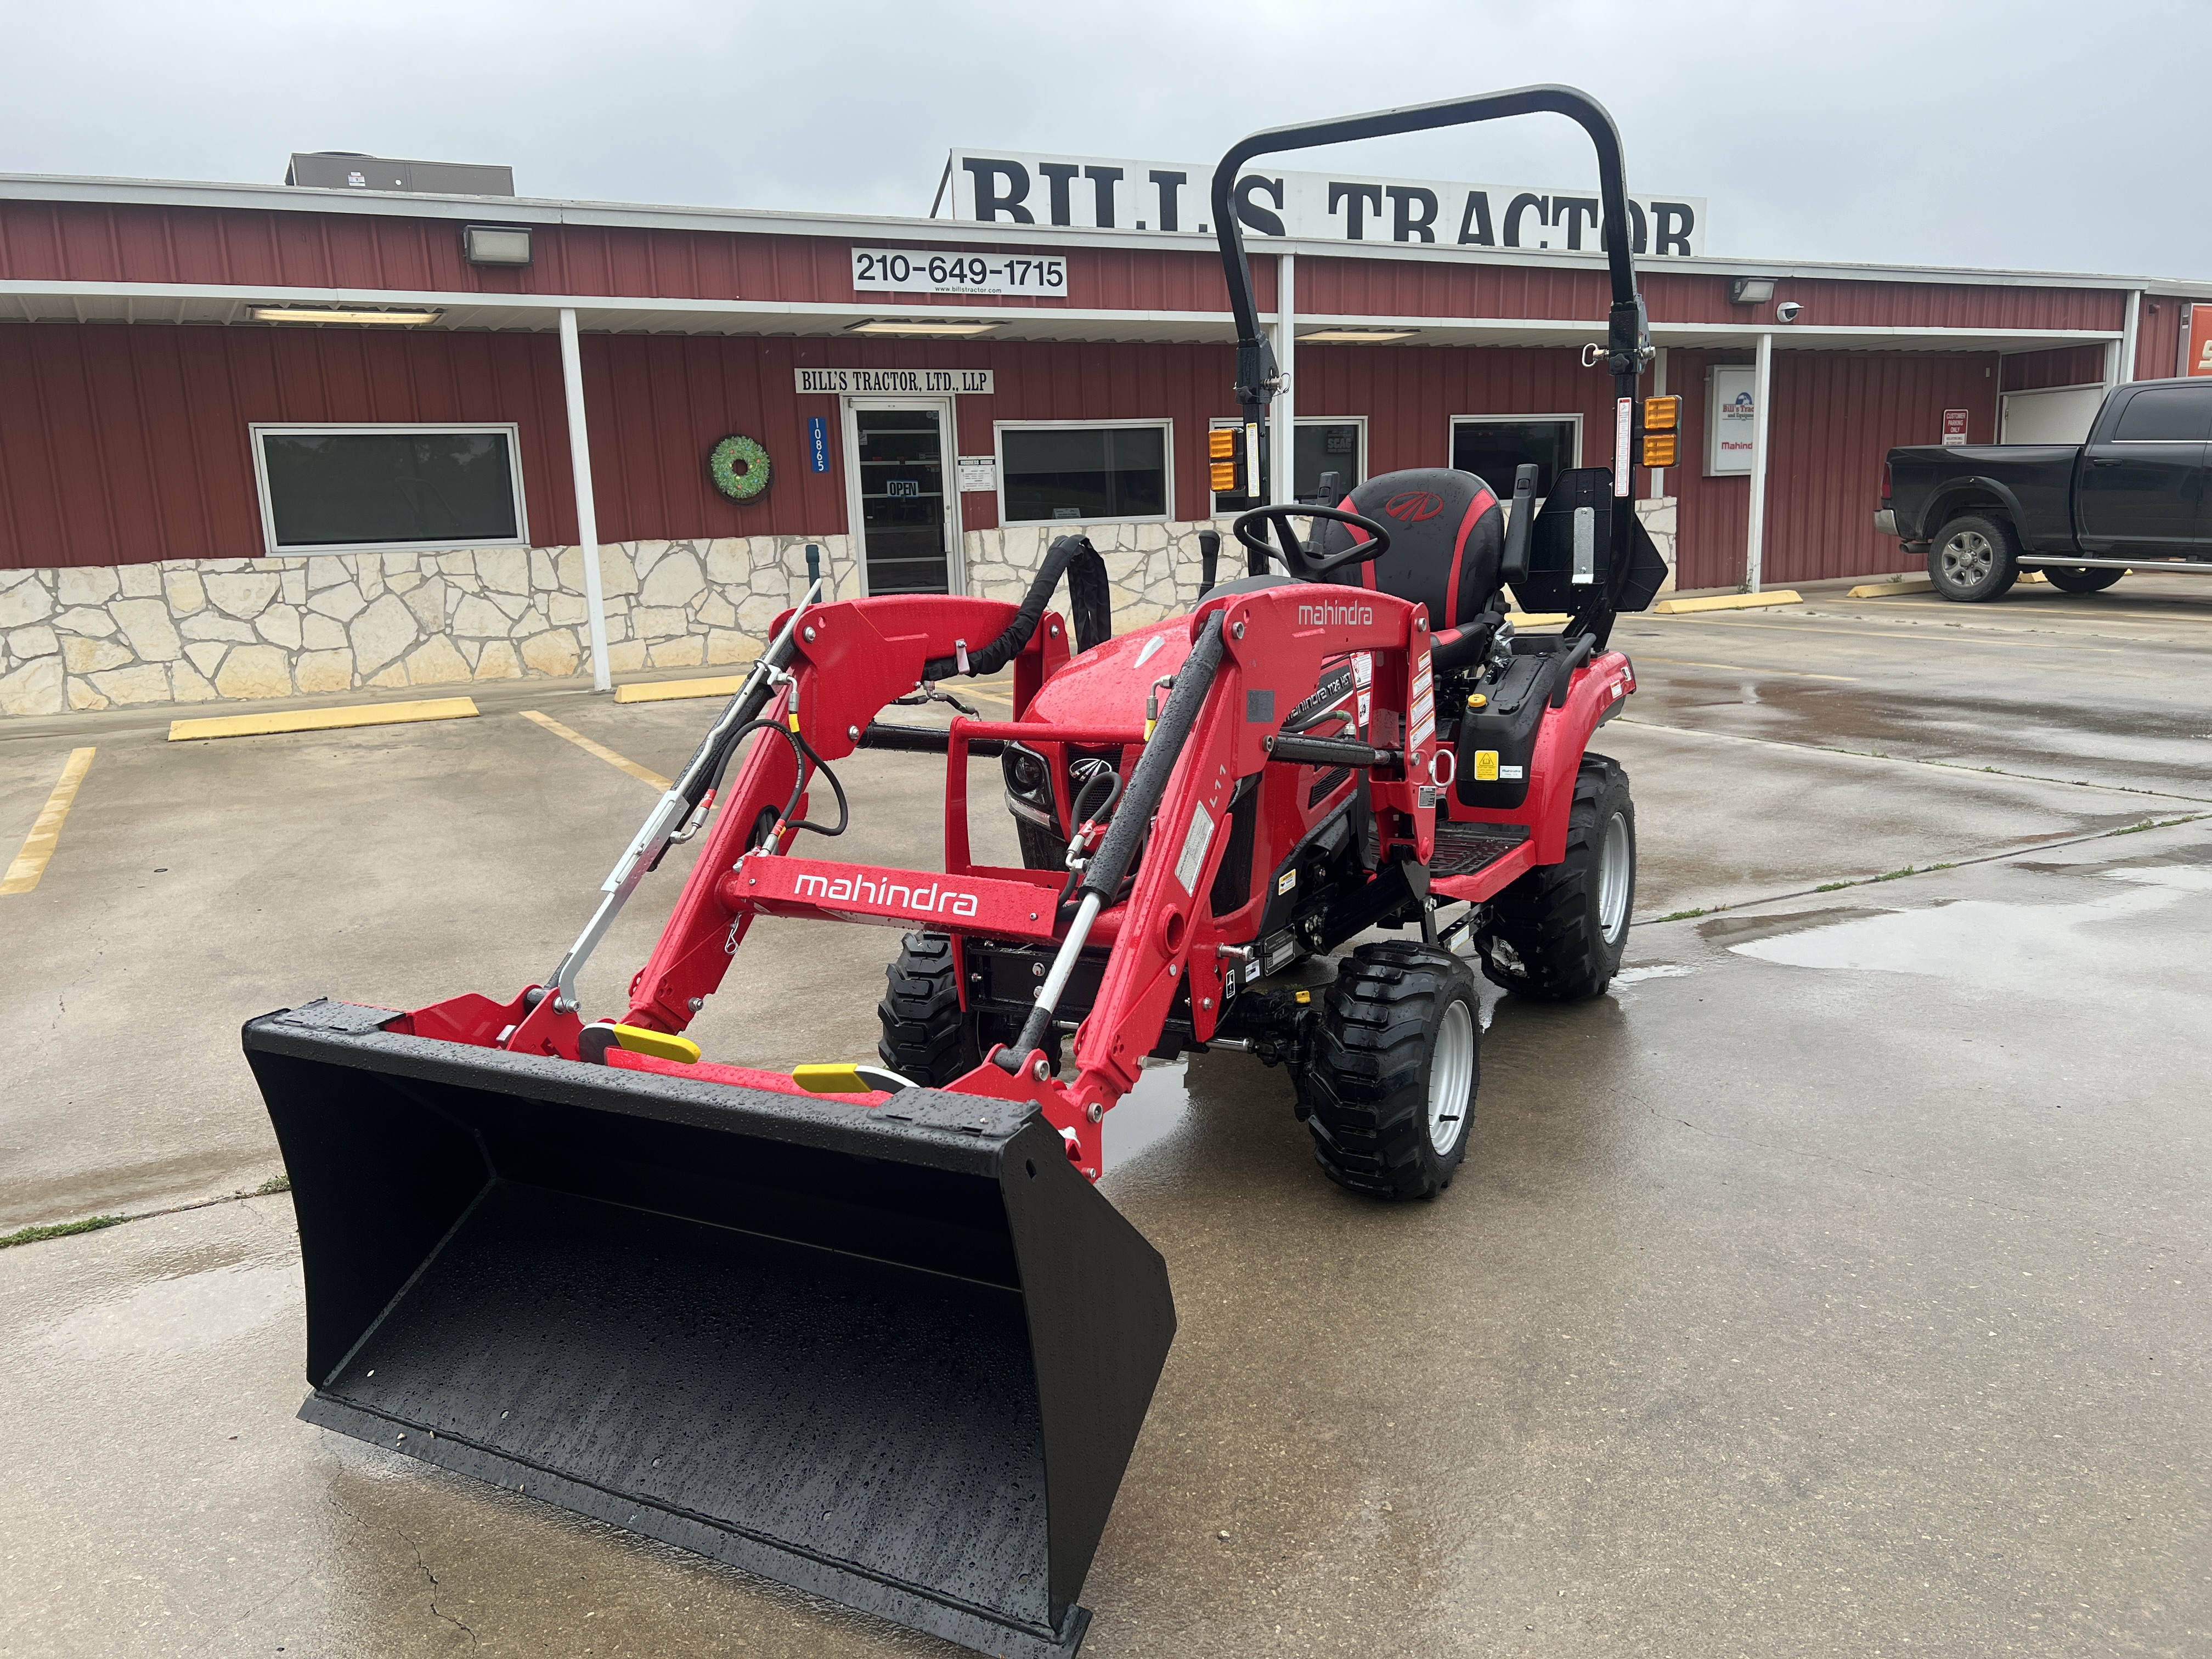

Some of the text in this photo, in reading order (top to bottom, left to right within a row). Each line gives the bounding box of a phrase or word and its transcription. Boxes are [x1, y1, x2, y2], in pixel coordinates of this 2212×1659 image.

[856, 253, 1063, 287] 210-649-1715
[935, 285, 1002, 294] www.billstractor.com
[802, 370, 987, 393] BILL'S TRACTOR, LTD., LLP
[815, 417, 824, 472] 10865
[889, 482, 917, 496] OPEN
[1298, 600, 1372, 625] mahindra
[1340, 672, 1351, 688] HST
[793, 873, 979, 917] mahindra
